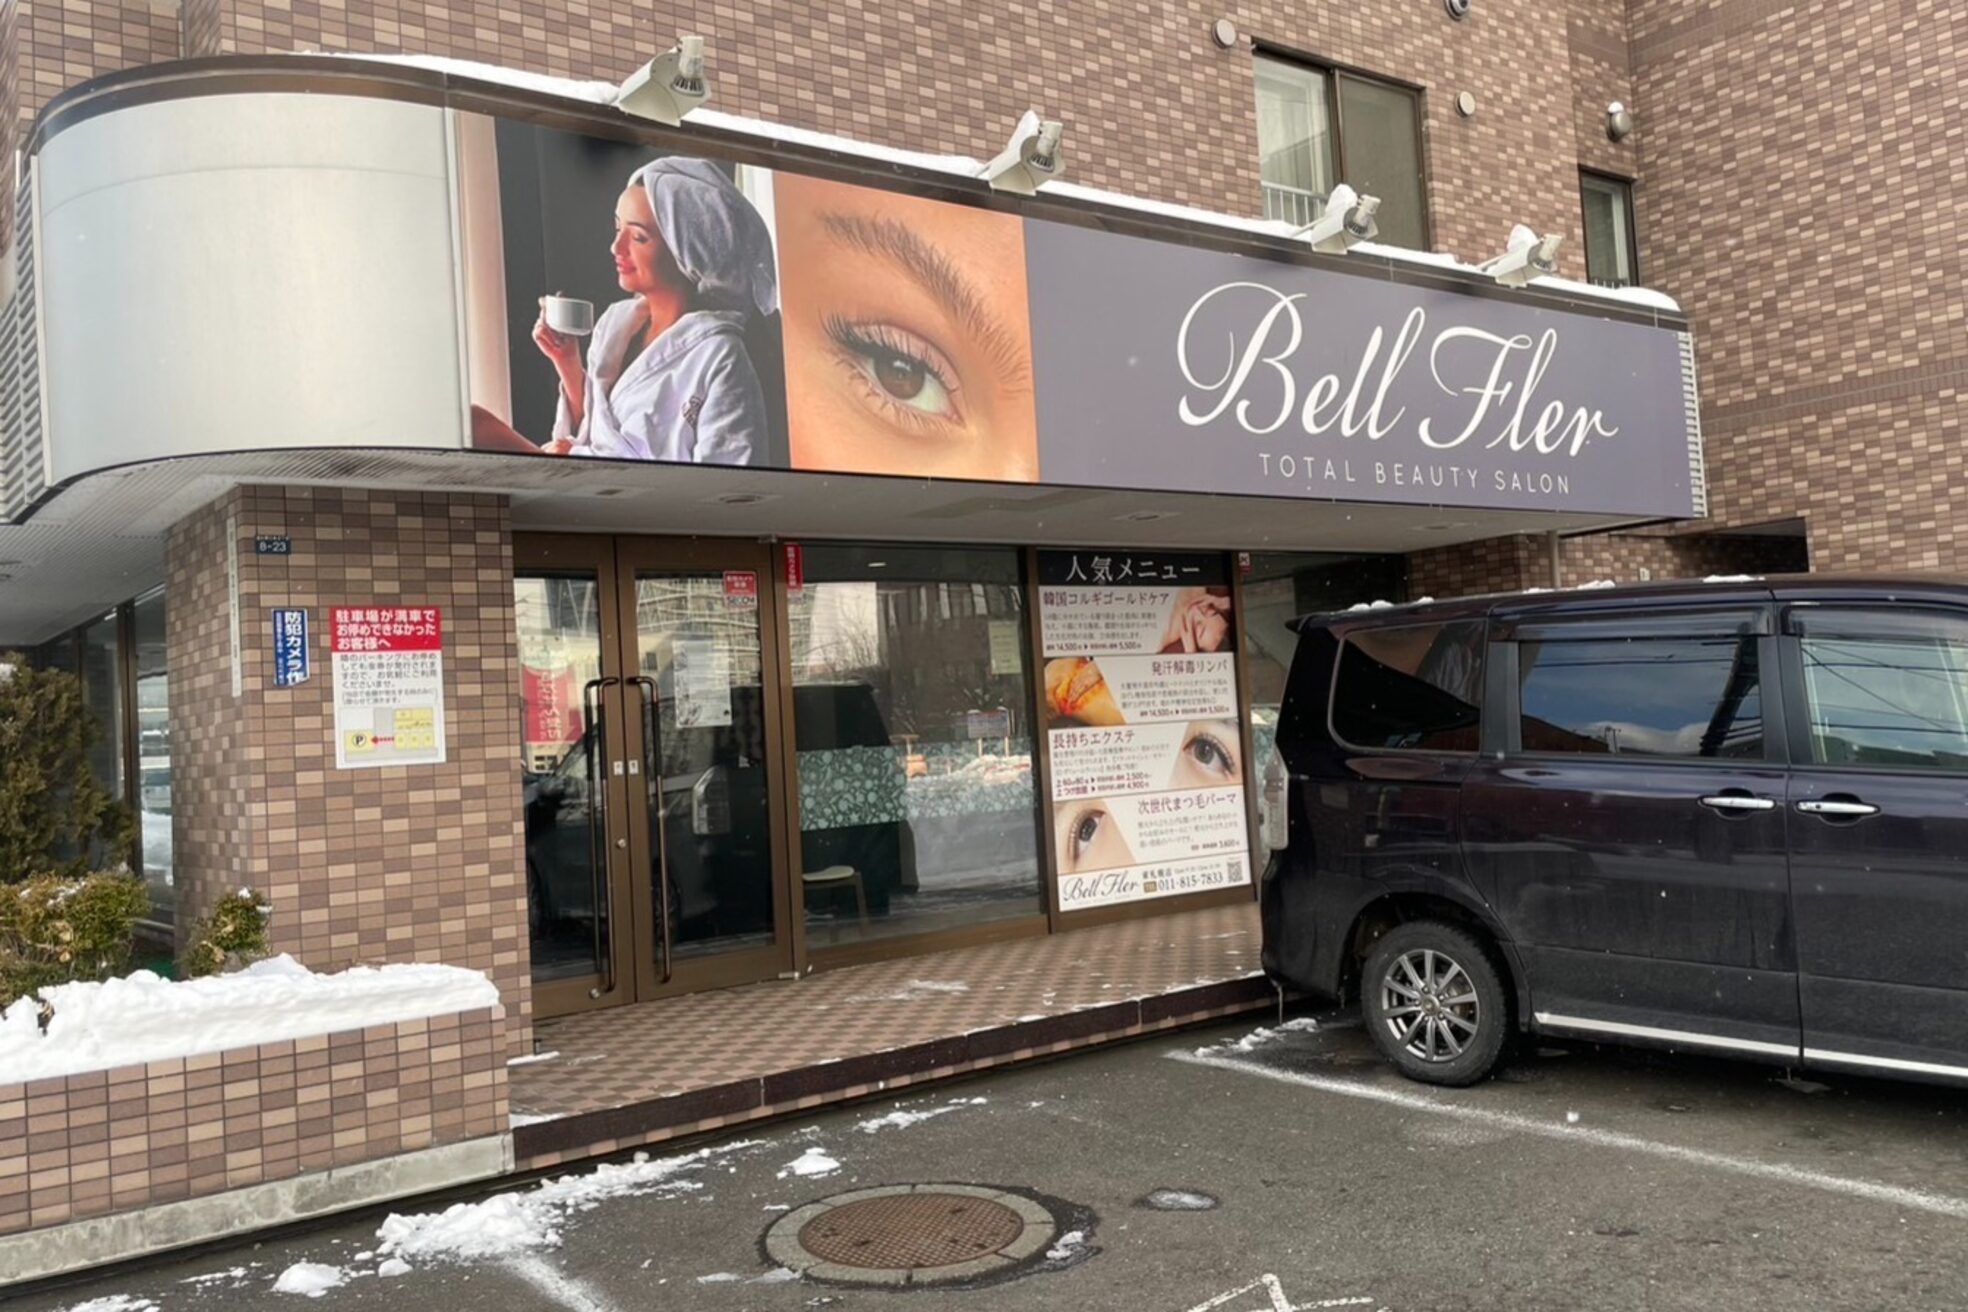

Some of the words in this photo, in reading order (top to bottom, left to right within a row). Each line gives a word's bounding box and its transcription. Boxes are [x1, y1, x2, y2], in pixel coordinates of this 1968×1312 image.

[1177, 282, 1425, 440] Bell
[1419, 326, 1618, 456] Fler
[1259, 452, 1356, 483] TOTAL
[1376, 461, 1478, 488] BEAUTY
[1495, 470, 1570, 494] SALON
[1065, 554, 1201, 583] 人気メニュー
[335, 610, 436, 624] 駐車場が満車で
[336, 624, 436, 637] お停めできなかった
[337, 637, 391, 650] お客様へ
[1053, 729, 1136, 750] 長持ちエクステ
[1063, 874, 1100, 902] Bell
[1101, 870, 1139, 896] Fler
